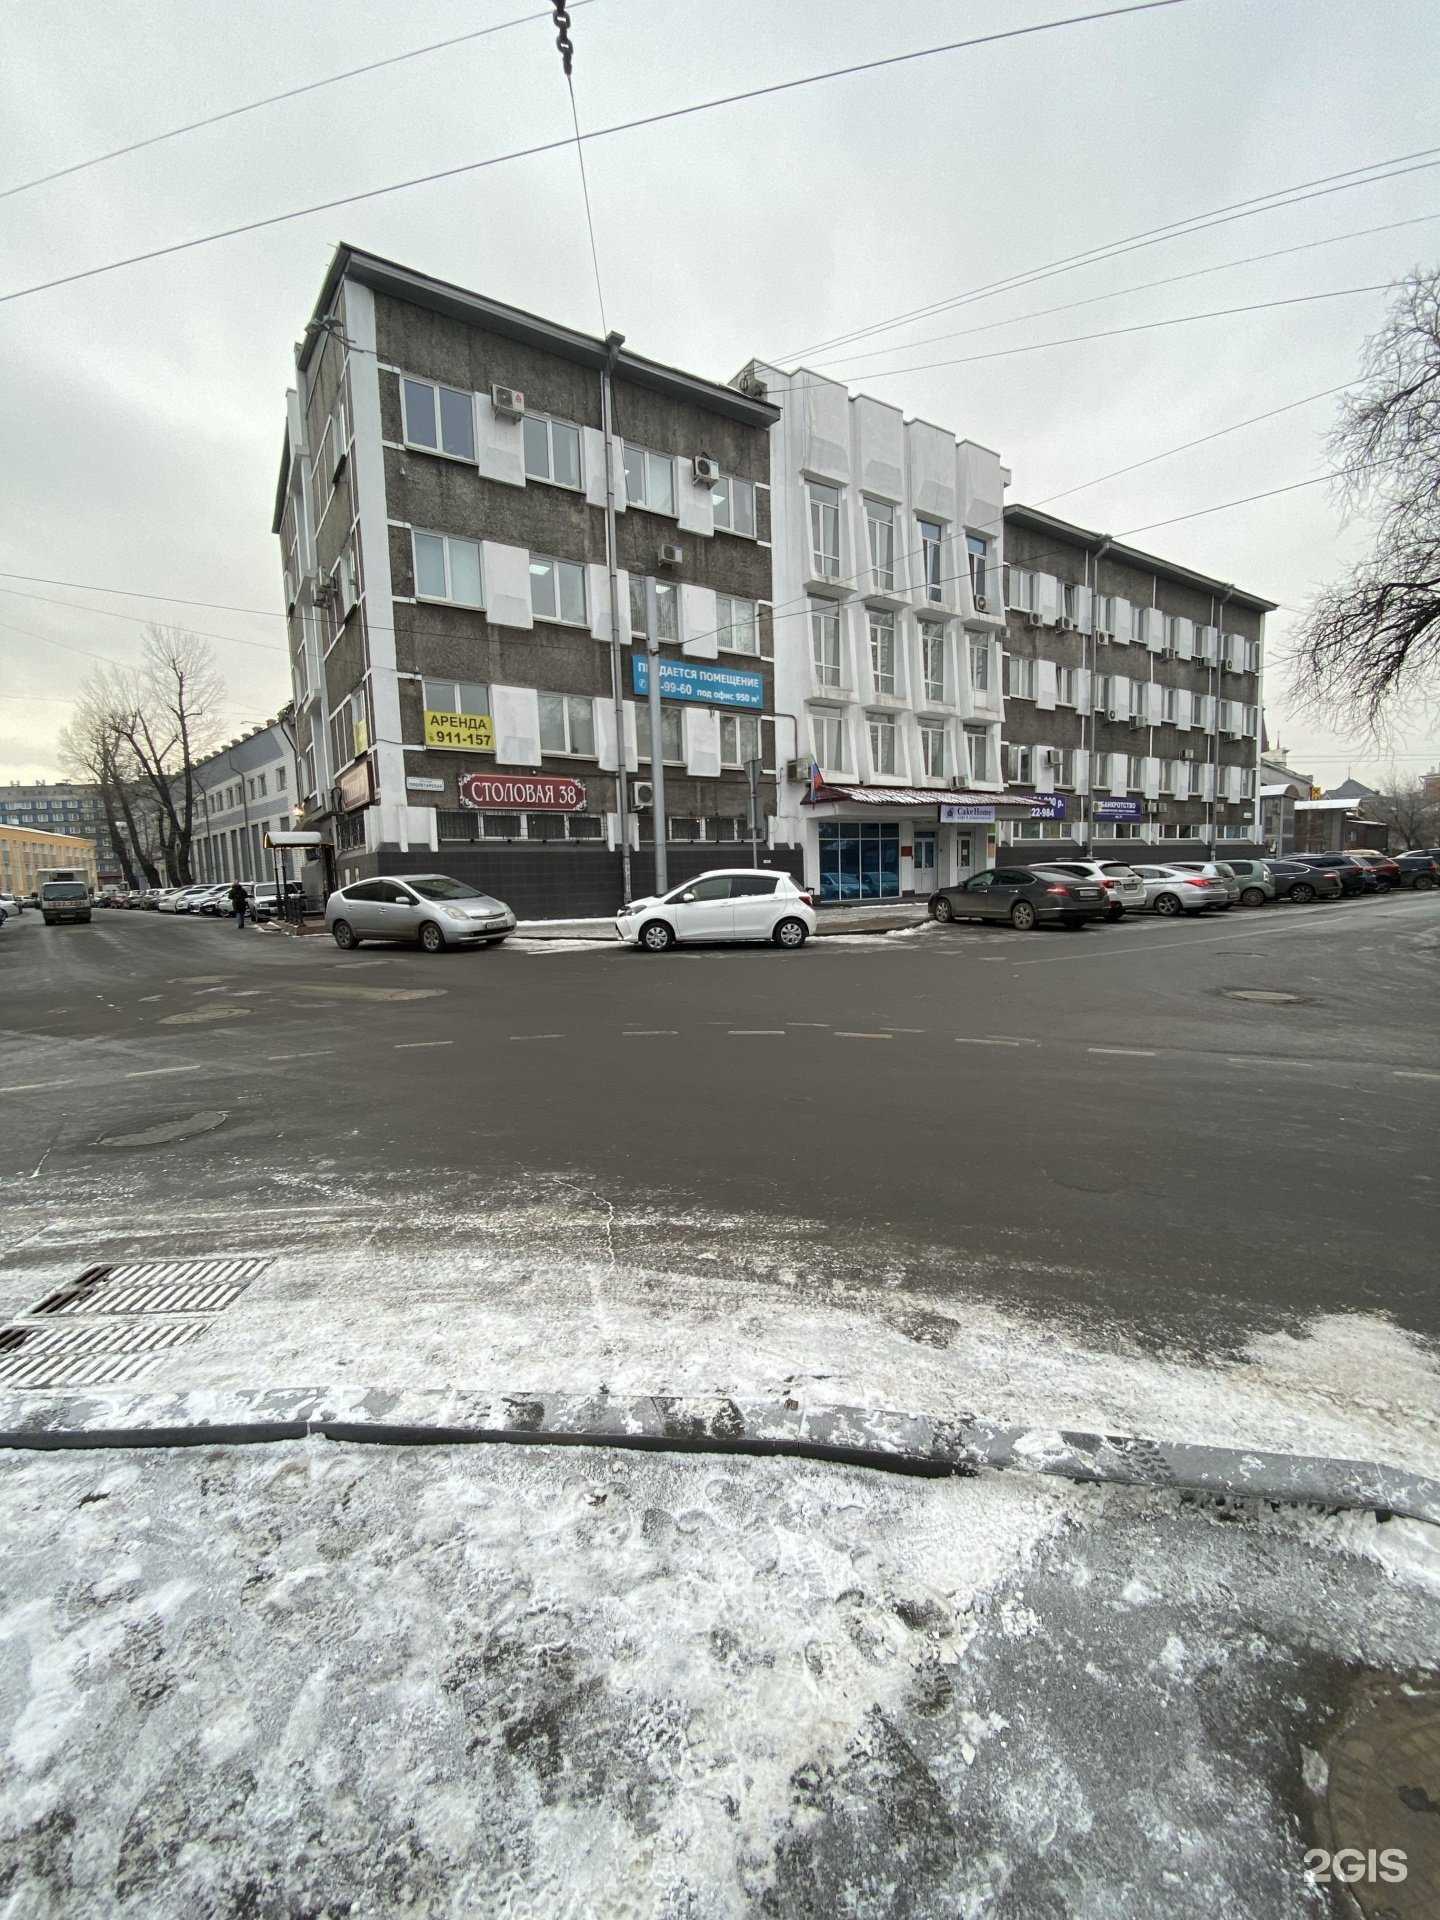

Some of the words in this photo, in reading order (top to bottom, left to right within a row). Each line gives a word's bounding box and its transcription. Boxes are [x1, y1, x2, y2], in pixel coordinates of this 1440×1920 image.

[638, 662, 697, 679] ПДАЕТСЯ
[699, 671, 759, 688] ПОМЕЩЕНИЕ
[696, 689, 712, 698] под
[713, 691, 733, 701] офис
[430, 714, 487, 731] АРЕНДА
[436, 730, 491, 746] 911-157
[471, 782, 554, 804] СТОЛОВАЯ
[559, 785, 577, 804] 38
